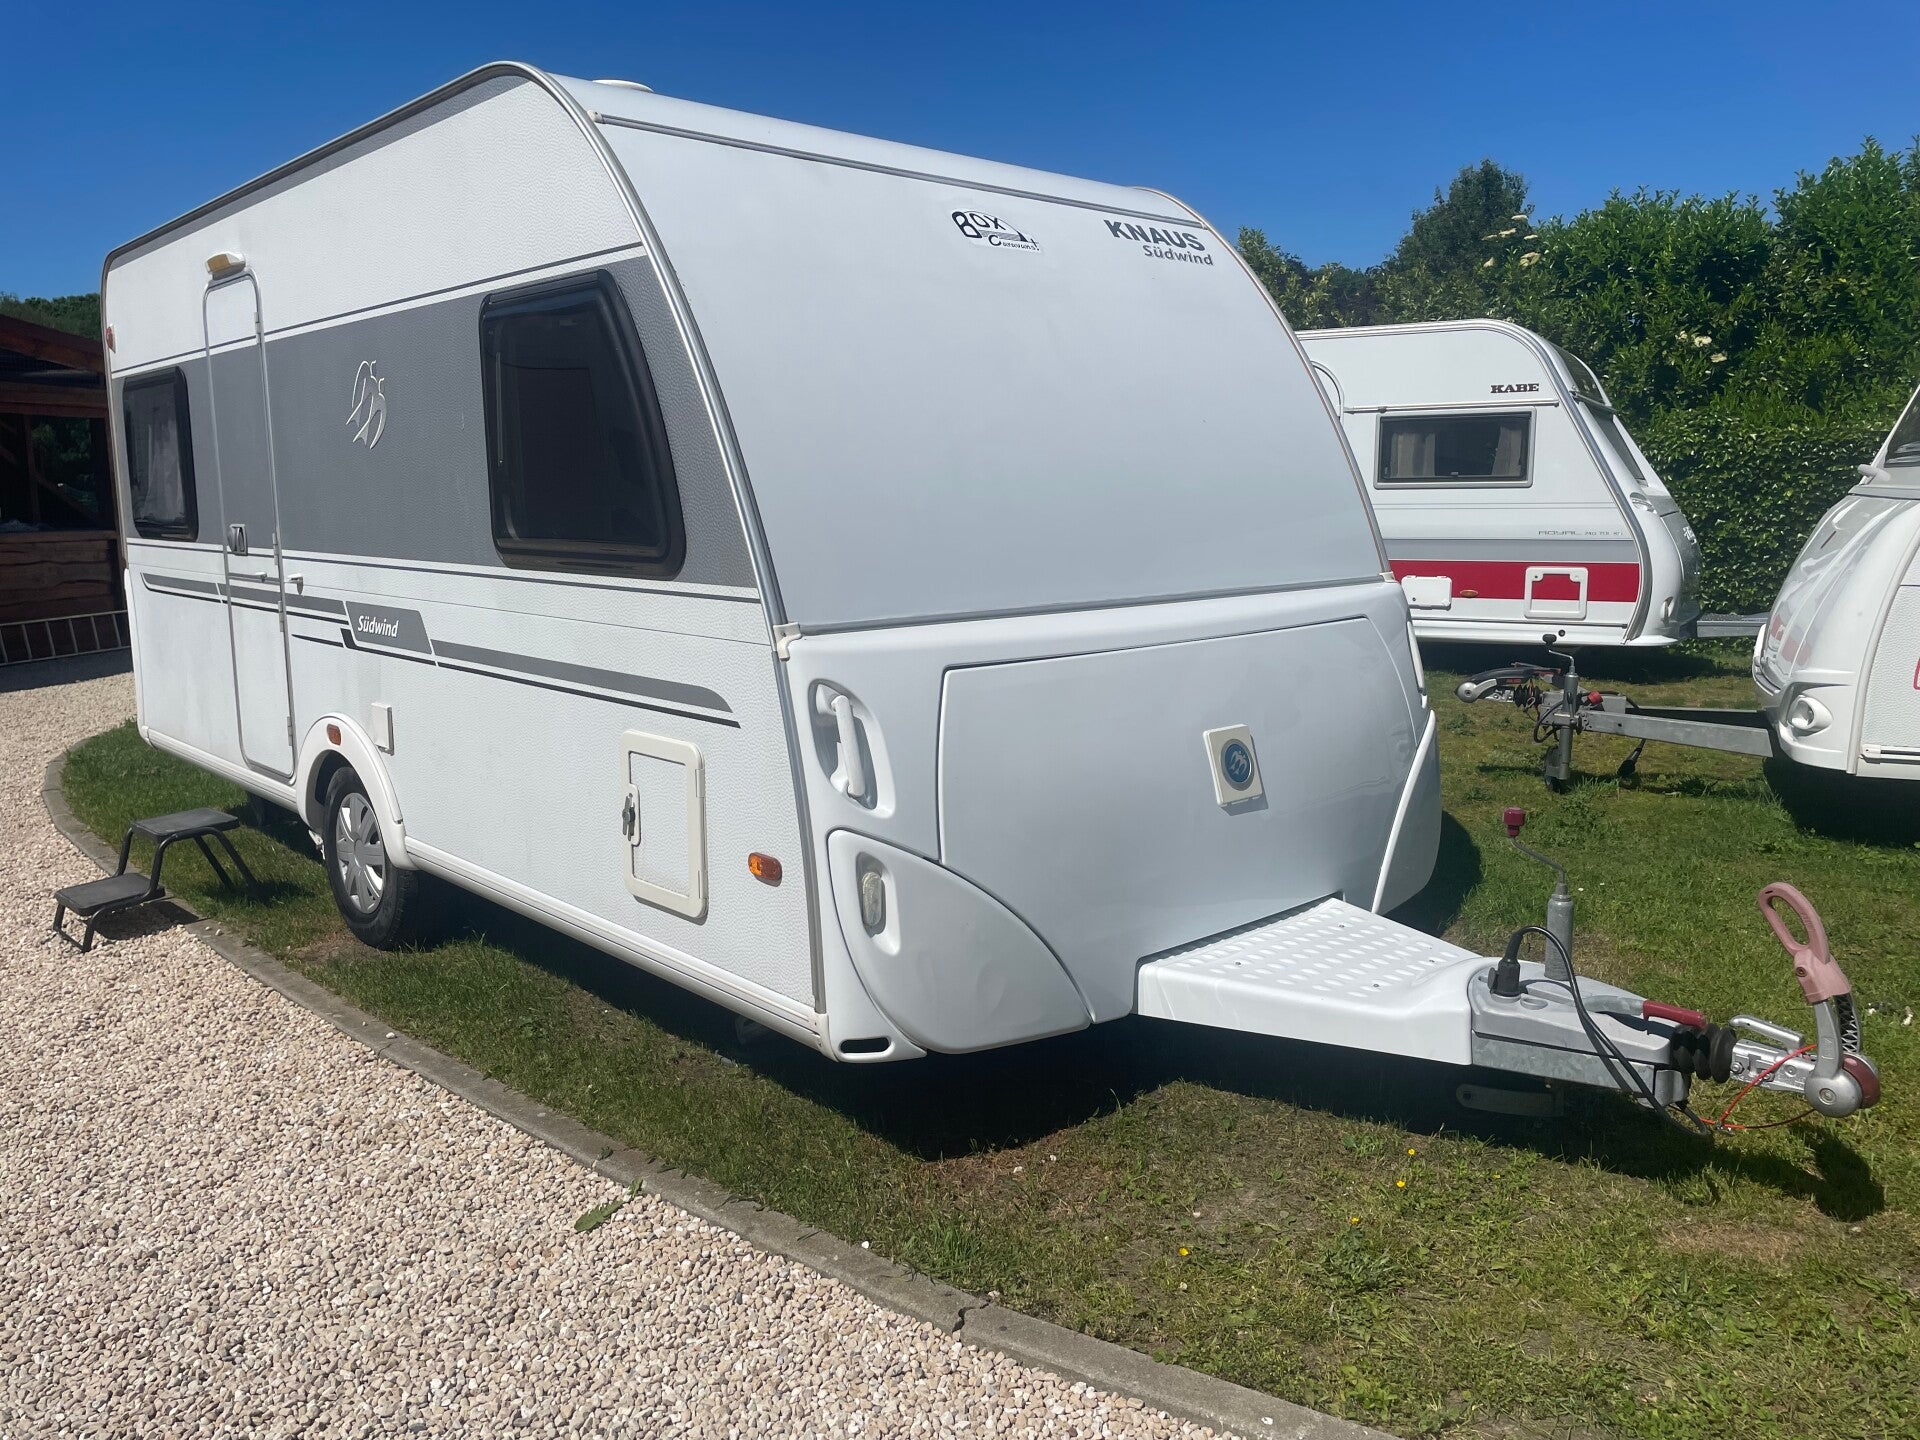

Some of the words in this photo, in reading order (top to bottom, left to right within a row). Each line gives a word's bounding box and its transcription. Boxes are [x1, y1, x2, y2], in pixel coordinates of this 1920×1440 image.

[1103, 219, 1206, 252] KNAUS
[1142, 244, 1214, 266] Südwind
[1490, 383, 1539, 393] KABE
[357, 615, 399, 637] Südwind
